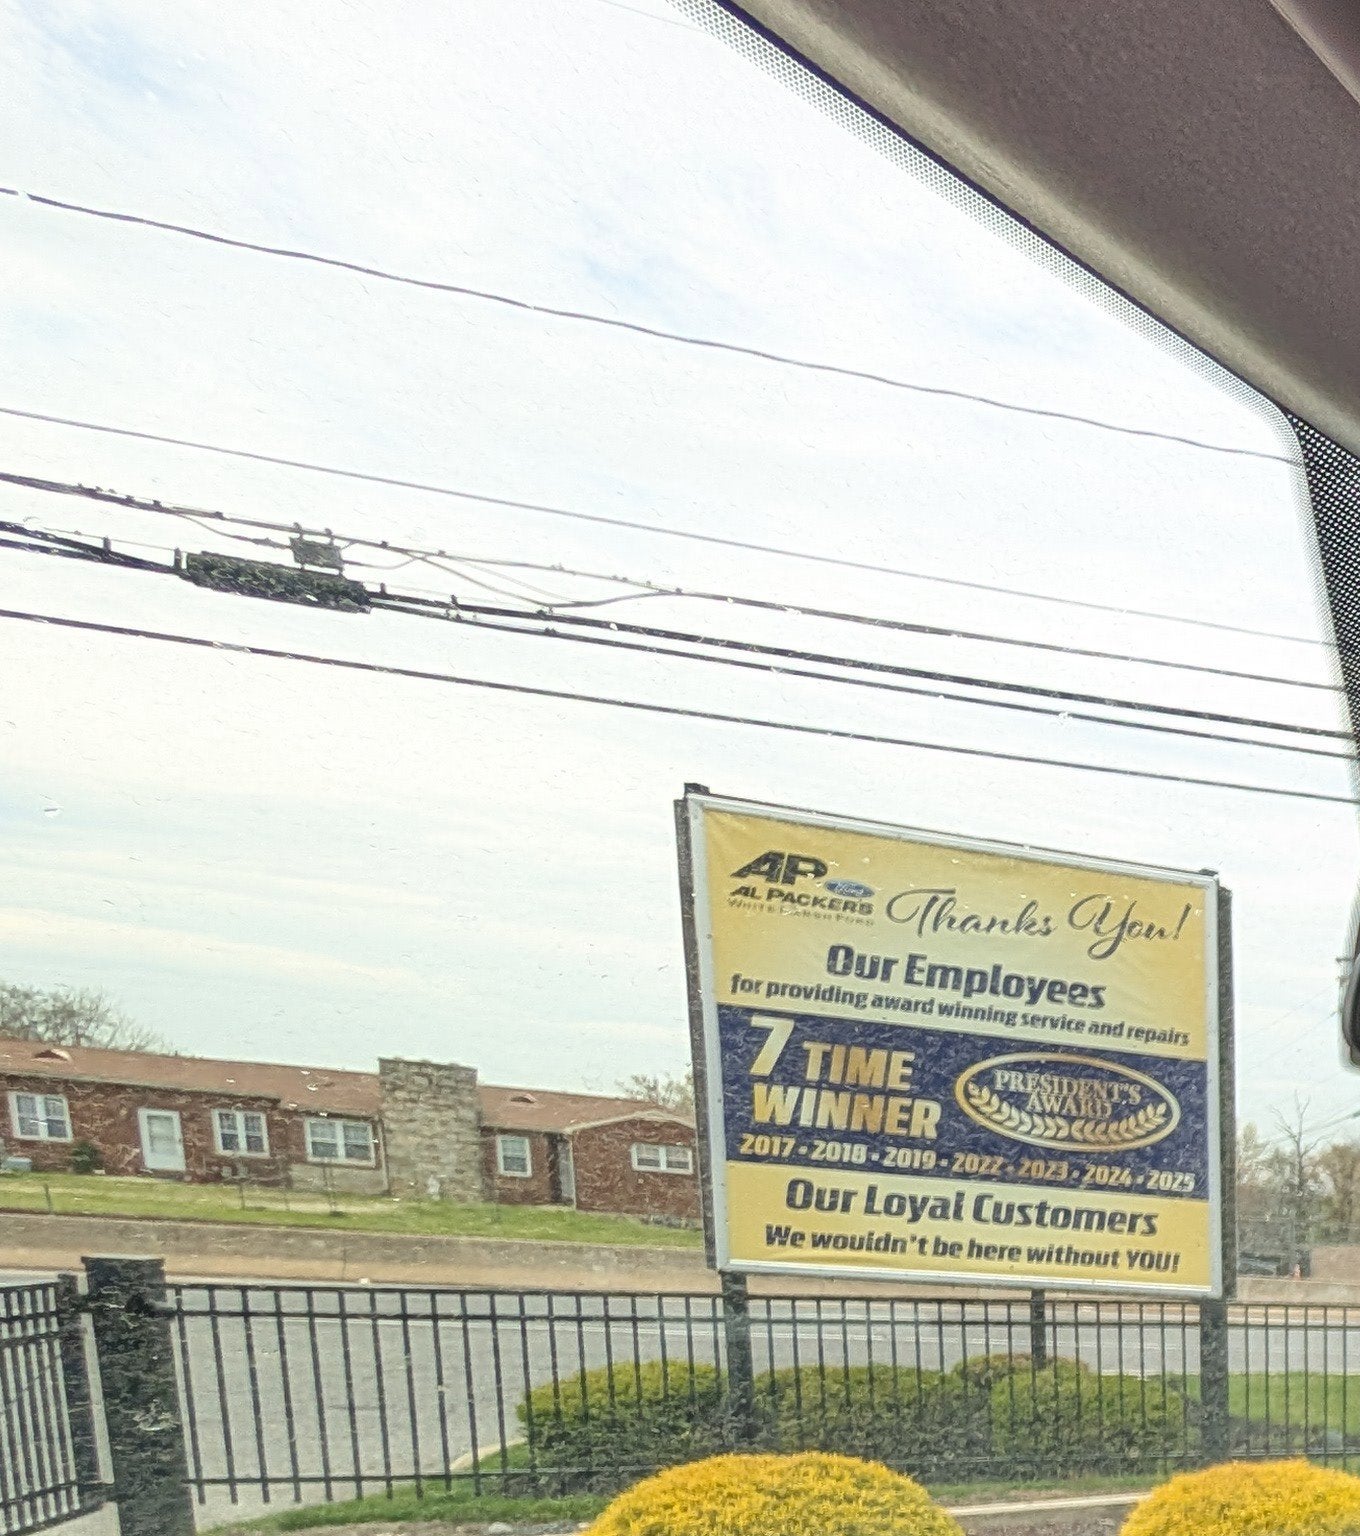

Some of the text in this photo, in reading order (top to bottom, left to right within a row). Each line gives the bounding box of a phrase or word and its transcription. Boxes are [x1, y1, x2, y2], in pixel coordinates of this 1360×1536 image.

[730, 851, 828, 885] AP
[730, 886, 762, 900] AL
[886, 888, 1192, 960] Thanks You!
[826, 943, 1107, 1008] Our Employees
[730, 973, 1191, 1047] for providing award winning service and repairs
[749, 1014, 915, 1092] 7 TIME
[753, 1082, 942, 1140] WINNER
[993, 1068, 1142, 1106] PRESIDENT'S
[1026, 1091, 1113, 1119] AWARD
[739, 1133, 1196, 1193] 2017 2018 2019 2022 2023 2024 2025
[786, 1178, 1160, 1237] Our Loyal Customers
[765, 1223, 806, 1248] We
[932, 1235, 964, 1259] be
[967, 1238, 1022, 1262] here
[1027, 1243, 1121, 1269] without
[1126, 1249, 1181, 1274] YOU!
